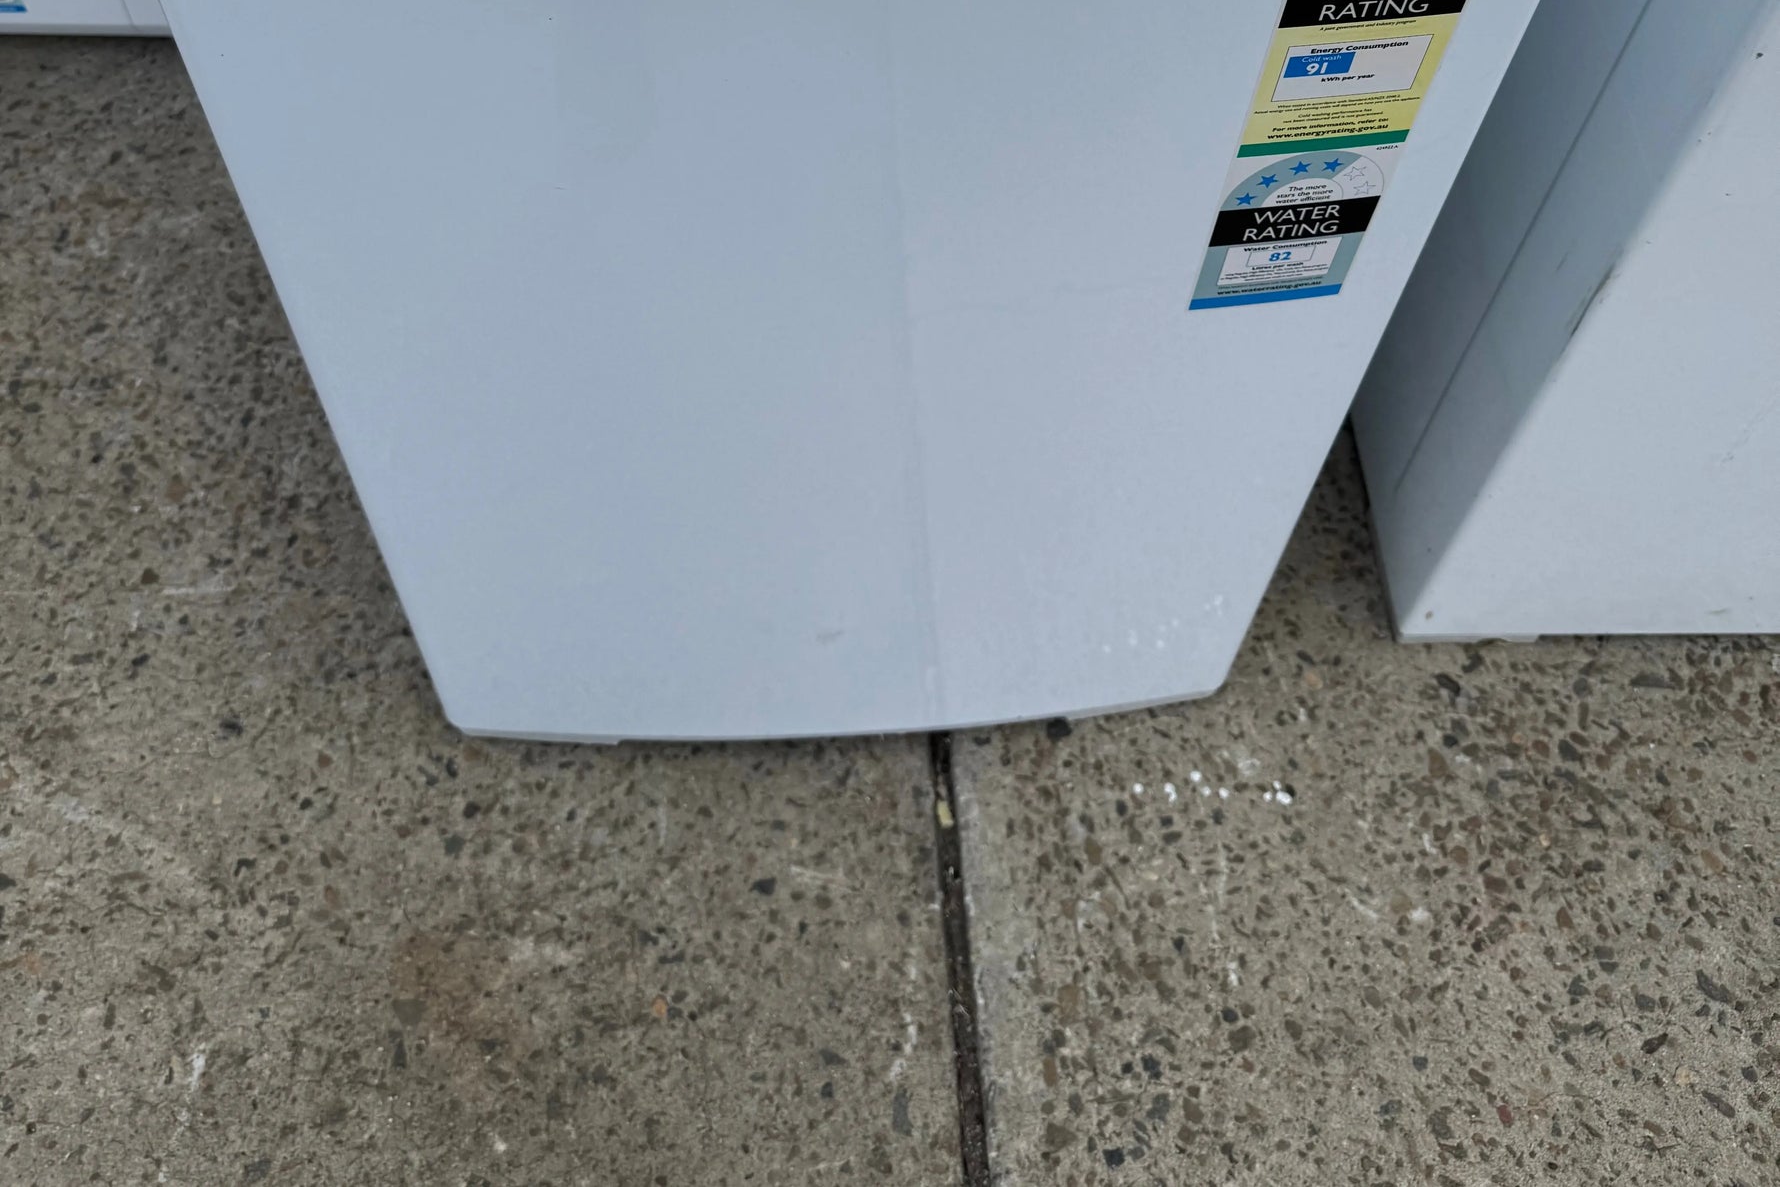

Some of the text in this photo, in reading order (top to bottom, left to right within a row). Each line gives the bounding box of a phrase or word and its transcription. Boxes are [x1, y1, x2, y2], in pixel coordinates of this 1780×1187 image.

[1310, 41, 1409, 55] Energy Consumption
[1306, 62, 1329, 75] 91
[1267, 124, 1388, 140] www.energyrating.gov.au
[1253, 204, 1341, 225] WATER
[1242, 220, 1340, 242] RATING
[1272, 240, 1328, 250] Consumption
[1268, 251, 1292, 262] 82
